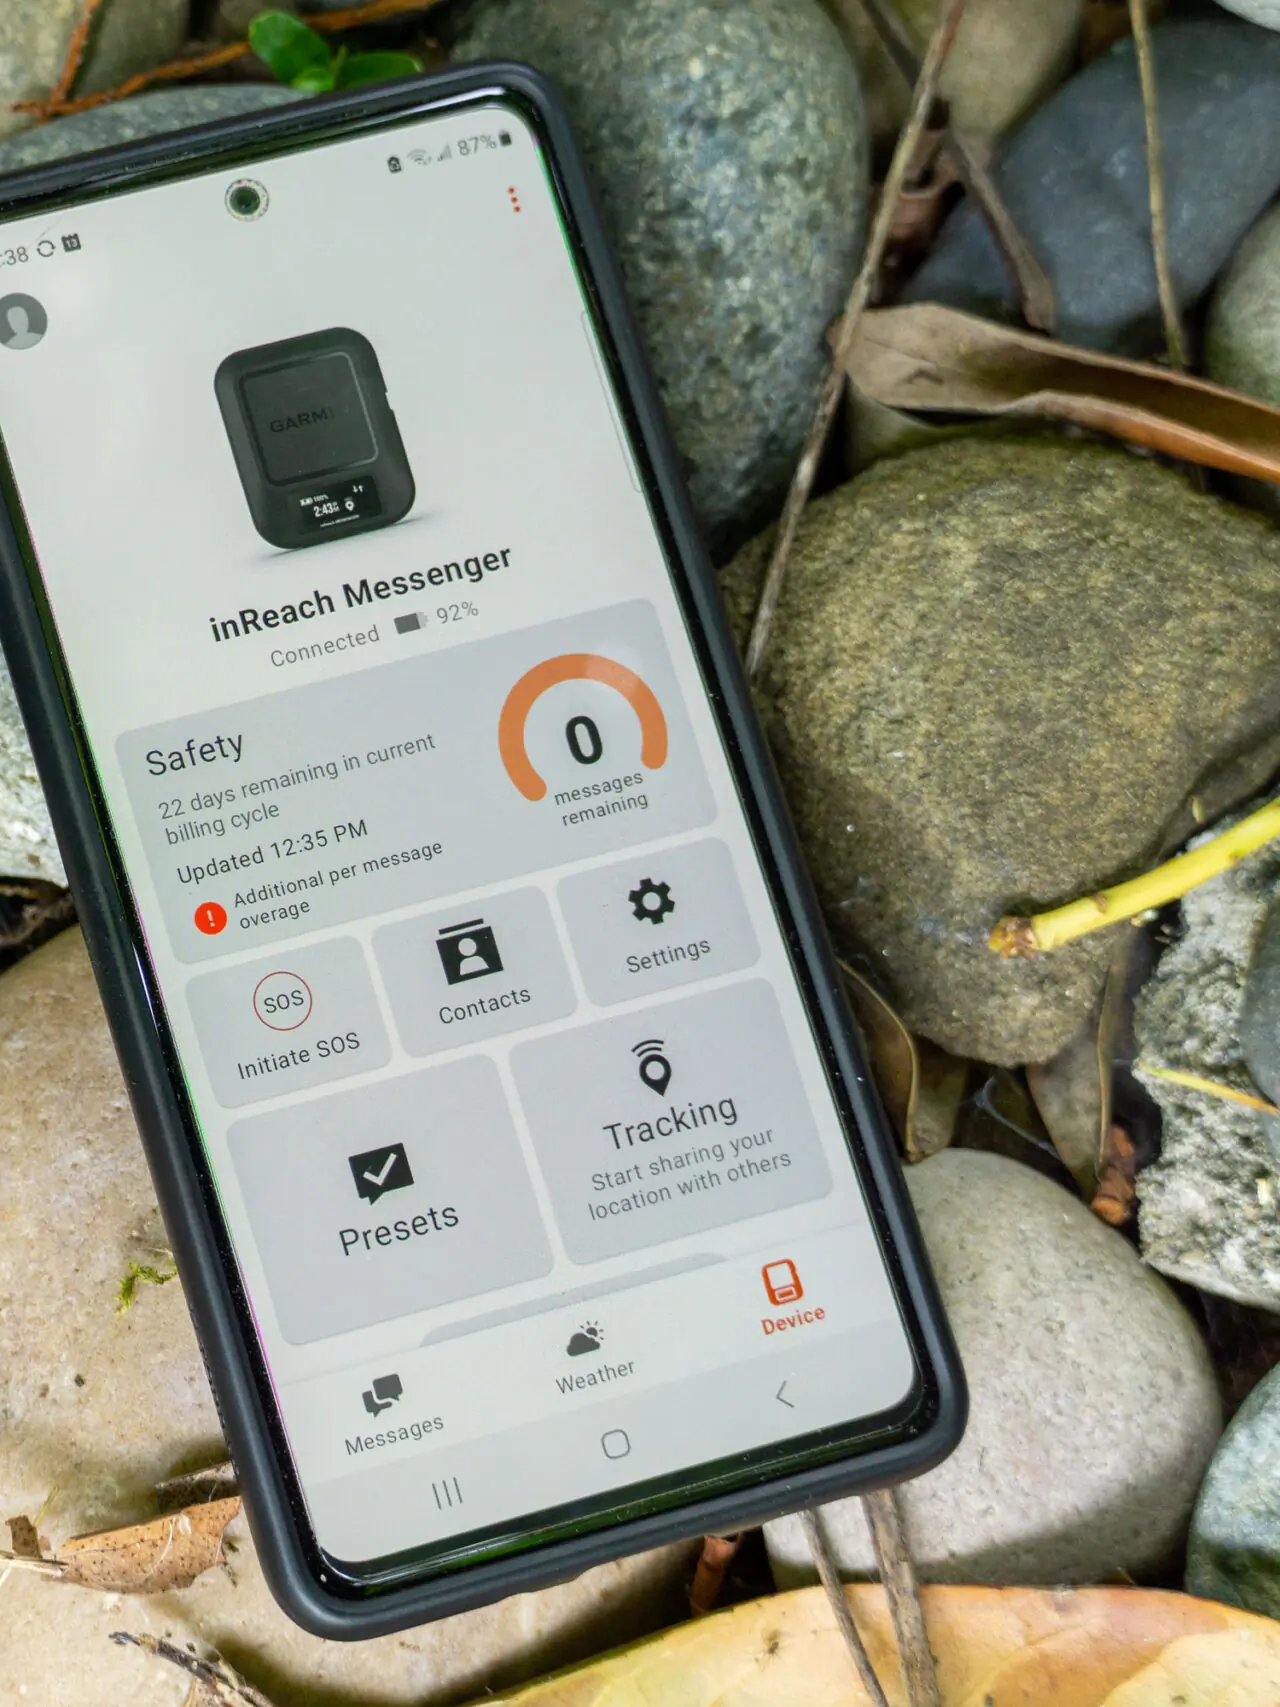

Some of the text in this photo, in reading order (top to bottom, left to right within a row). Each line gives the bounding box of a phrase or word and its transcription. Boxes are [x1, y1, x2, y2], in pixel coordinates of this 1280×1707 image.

[457, 135, 497, 156] 87%
[269, 407, 335, 433] GARMI
[209, 548, 512, 642] inReach Messenger
[270, 601, 479, 667] Connected 92%
[145, 734, 244, 776] Safety
[565, 715, 603, 765] 0
[158, 734, 436, 820] 22 days remaining in current
[554, 772, 644, 805] messages
[165, 801, 280, 845] billing cycle
[562, 793, 649, 826] remaining
[177, 820, 368, 884] Updated 12:35 PM
[234, 841, 443, 907] Additional per message
[240, 900, 311, 929] overage
[626, 938, 711, 973] Settings
[263, 989, 305, 1014] SOS
[438, 987, 532, 1025] Contacts
[237, 1032, 361, 1080] Initiate SOS
[602, 1098, 739, 1151] Tracking
[591, 1127, 775, 1192] Start sharing your
[588, 1151, 792, 1221] location with others
[338, 1205, 460, 1257] Presets
[761, 1304, 826, 1336] Device
[555, 1359, 636, 1394] Weather
[344, 1413, 444, 1456] Messages
